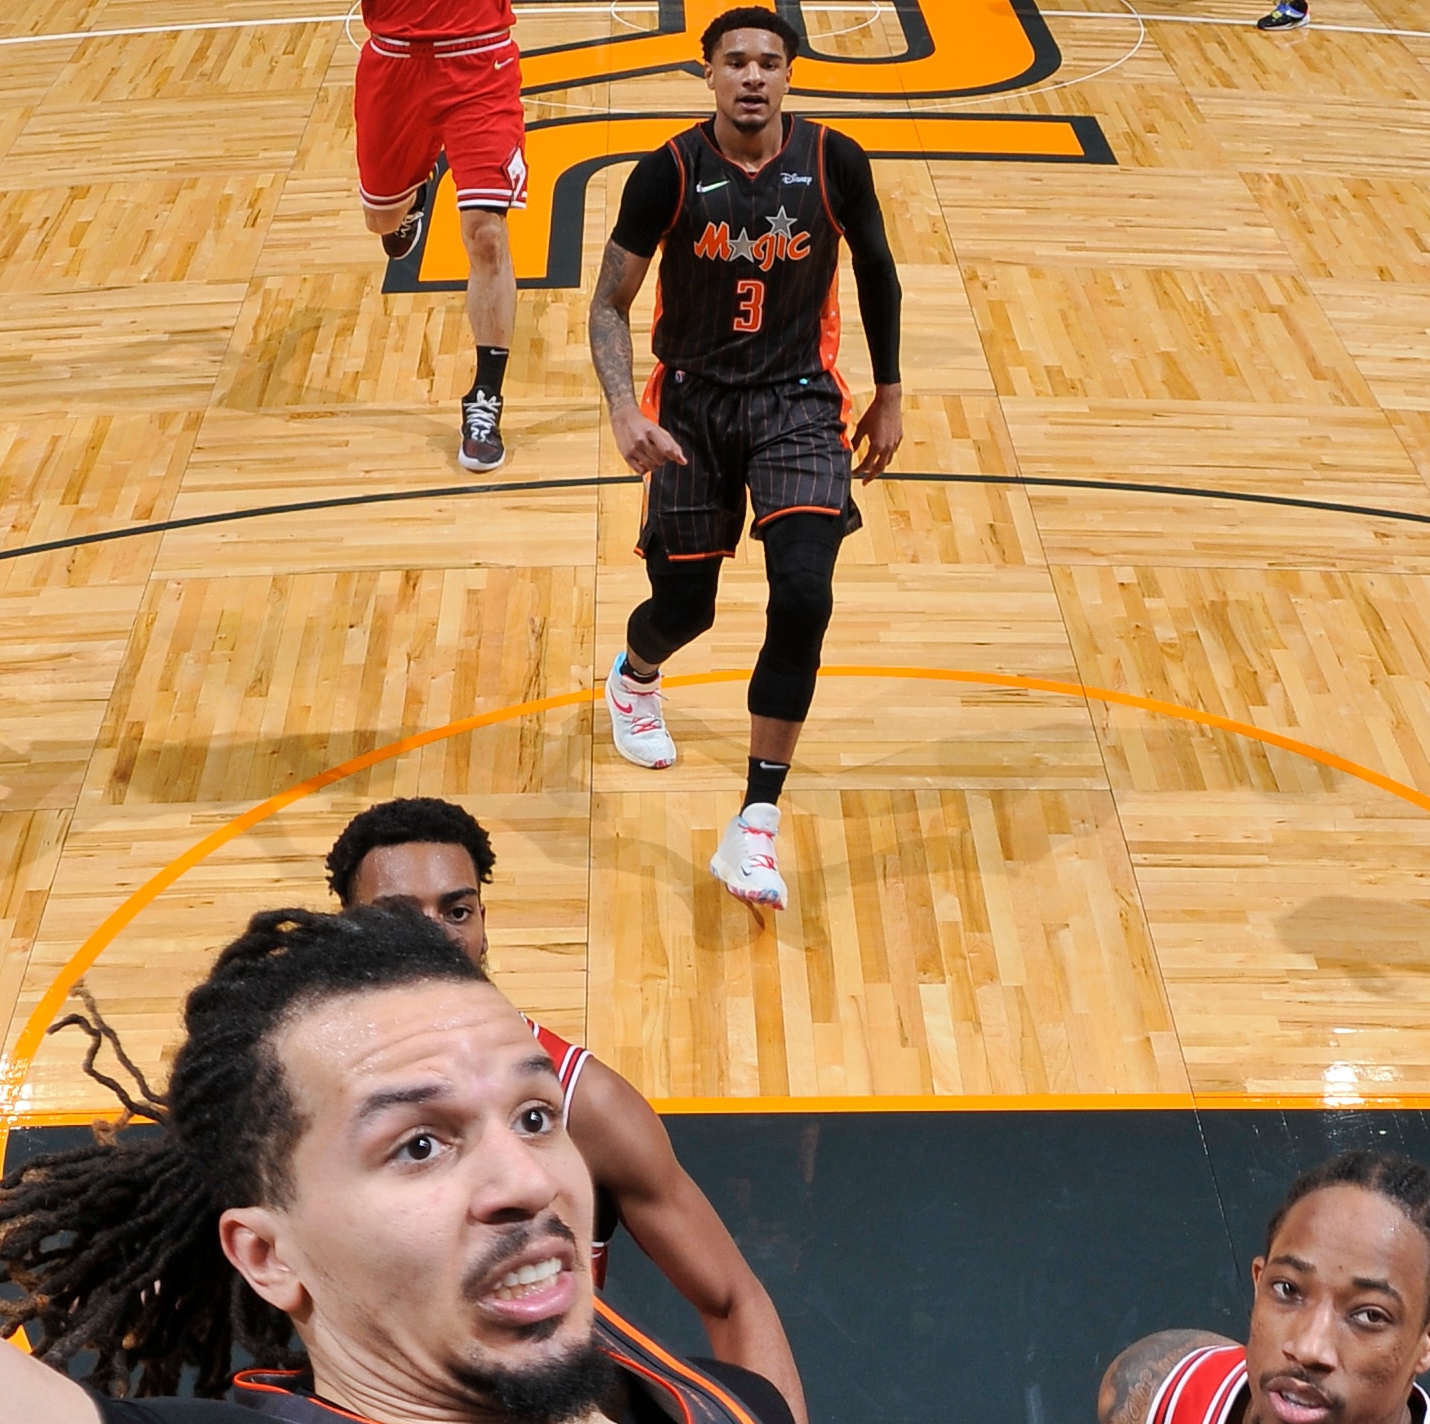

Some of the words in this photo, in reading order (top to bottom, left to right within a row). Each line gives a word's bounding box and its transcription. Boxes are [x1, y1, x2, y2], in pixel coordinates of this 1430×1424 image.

[780, 172, 813, 186] Disney
[694, 205, 811, 272] Magic
[733, 280, 765, 333] 3
